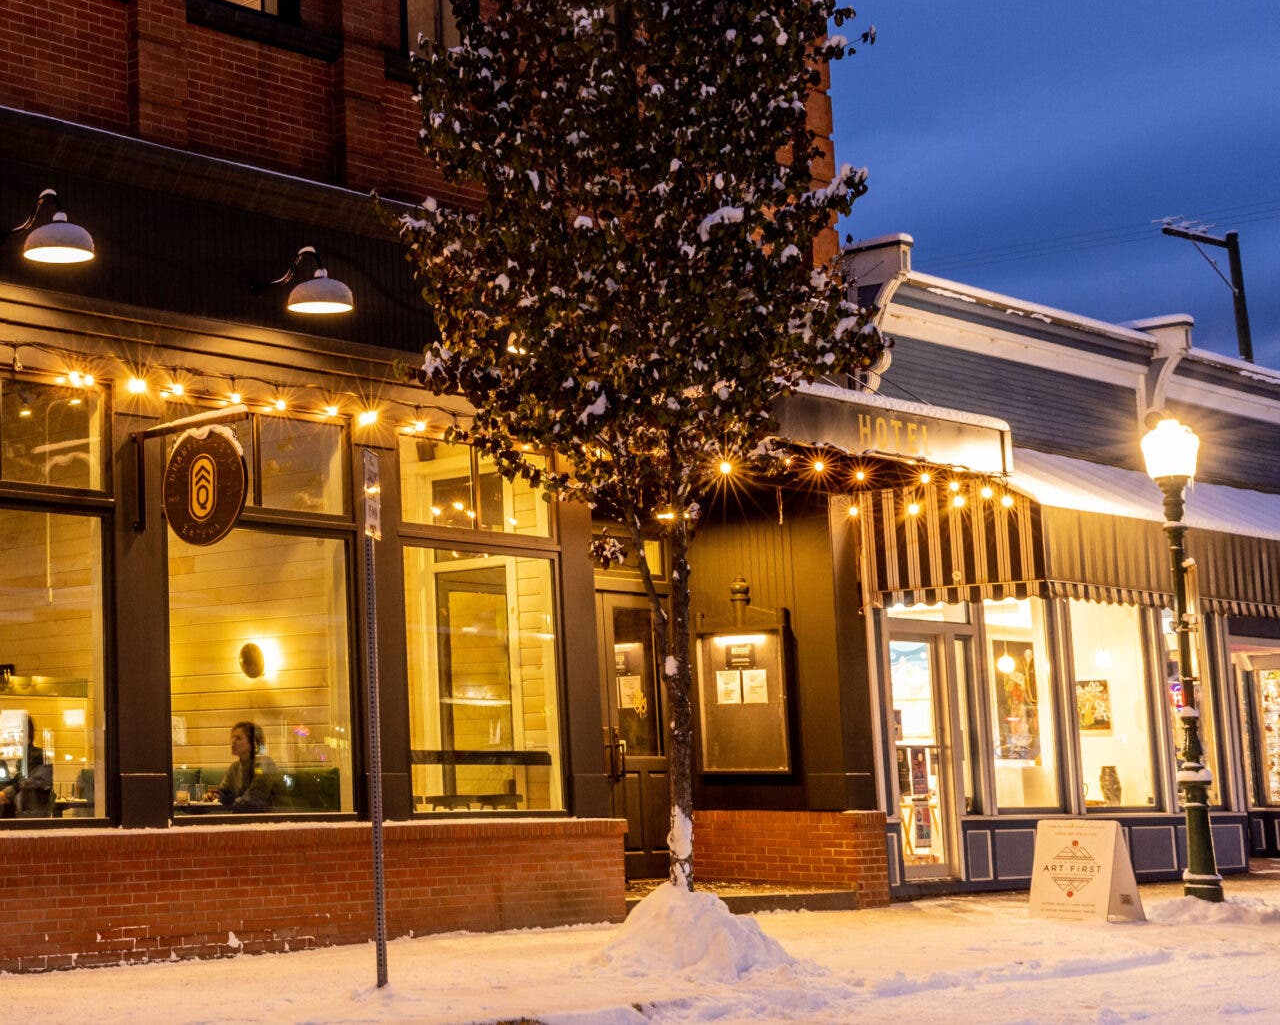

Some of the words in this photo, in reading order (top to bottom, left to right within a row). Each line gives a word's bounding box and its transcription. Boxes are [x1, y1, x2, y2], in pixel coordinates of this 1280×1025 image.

[858, 413, 931, 454] HOTEL
[196, 484, 209, 510] Q
[1042, 864, 1064, 872] ART
[1070, 865, 1103, 874] FIRST
